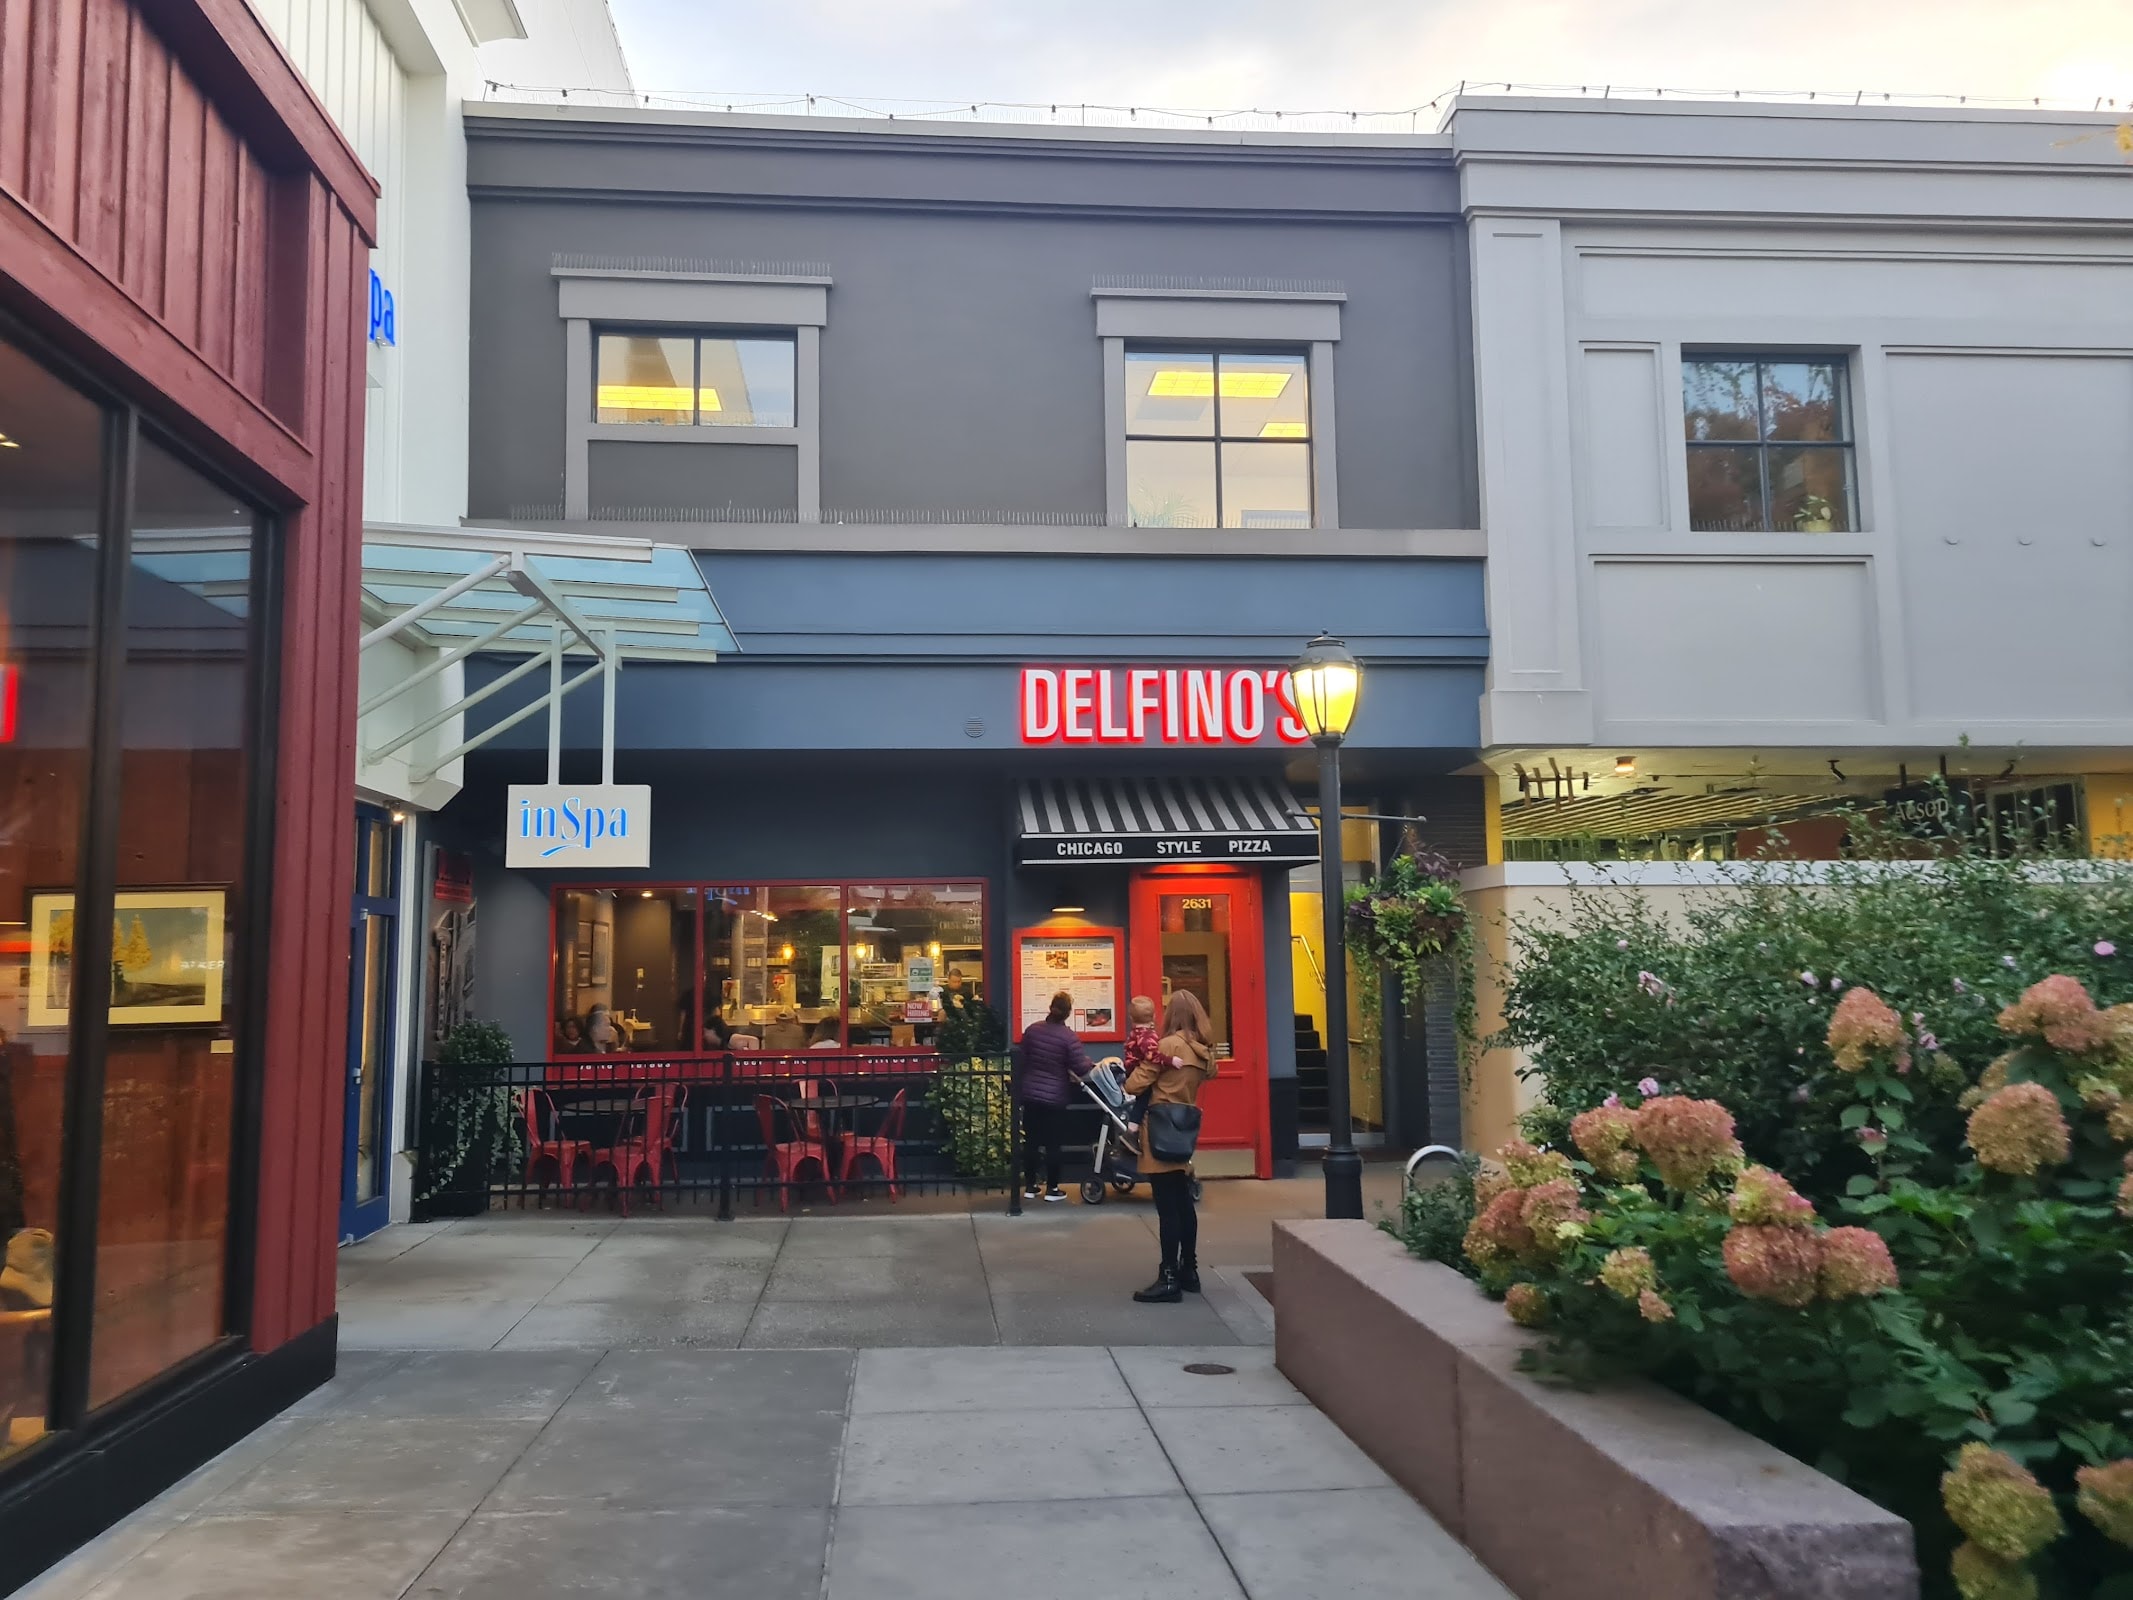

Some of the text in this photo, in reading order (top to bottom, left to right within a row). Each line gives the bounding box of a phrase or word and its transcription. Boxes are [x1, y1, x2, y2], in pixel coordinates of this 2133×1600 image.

[1021, 669, 1309, 742] DELFINO'S
[519, 797, 629, 849] inSpa
[1056, 840, 1272, 856] CHICAGO STYLE PIZZA
[1182, 898, 1212, 909] 2631
[906, 1002, 923, 1010] NOW
